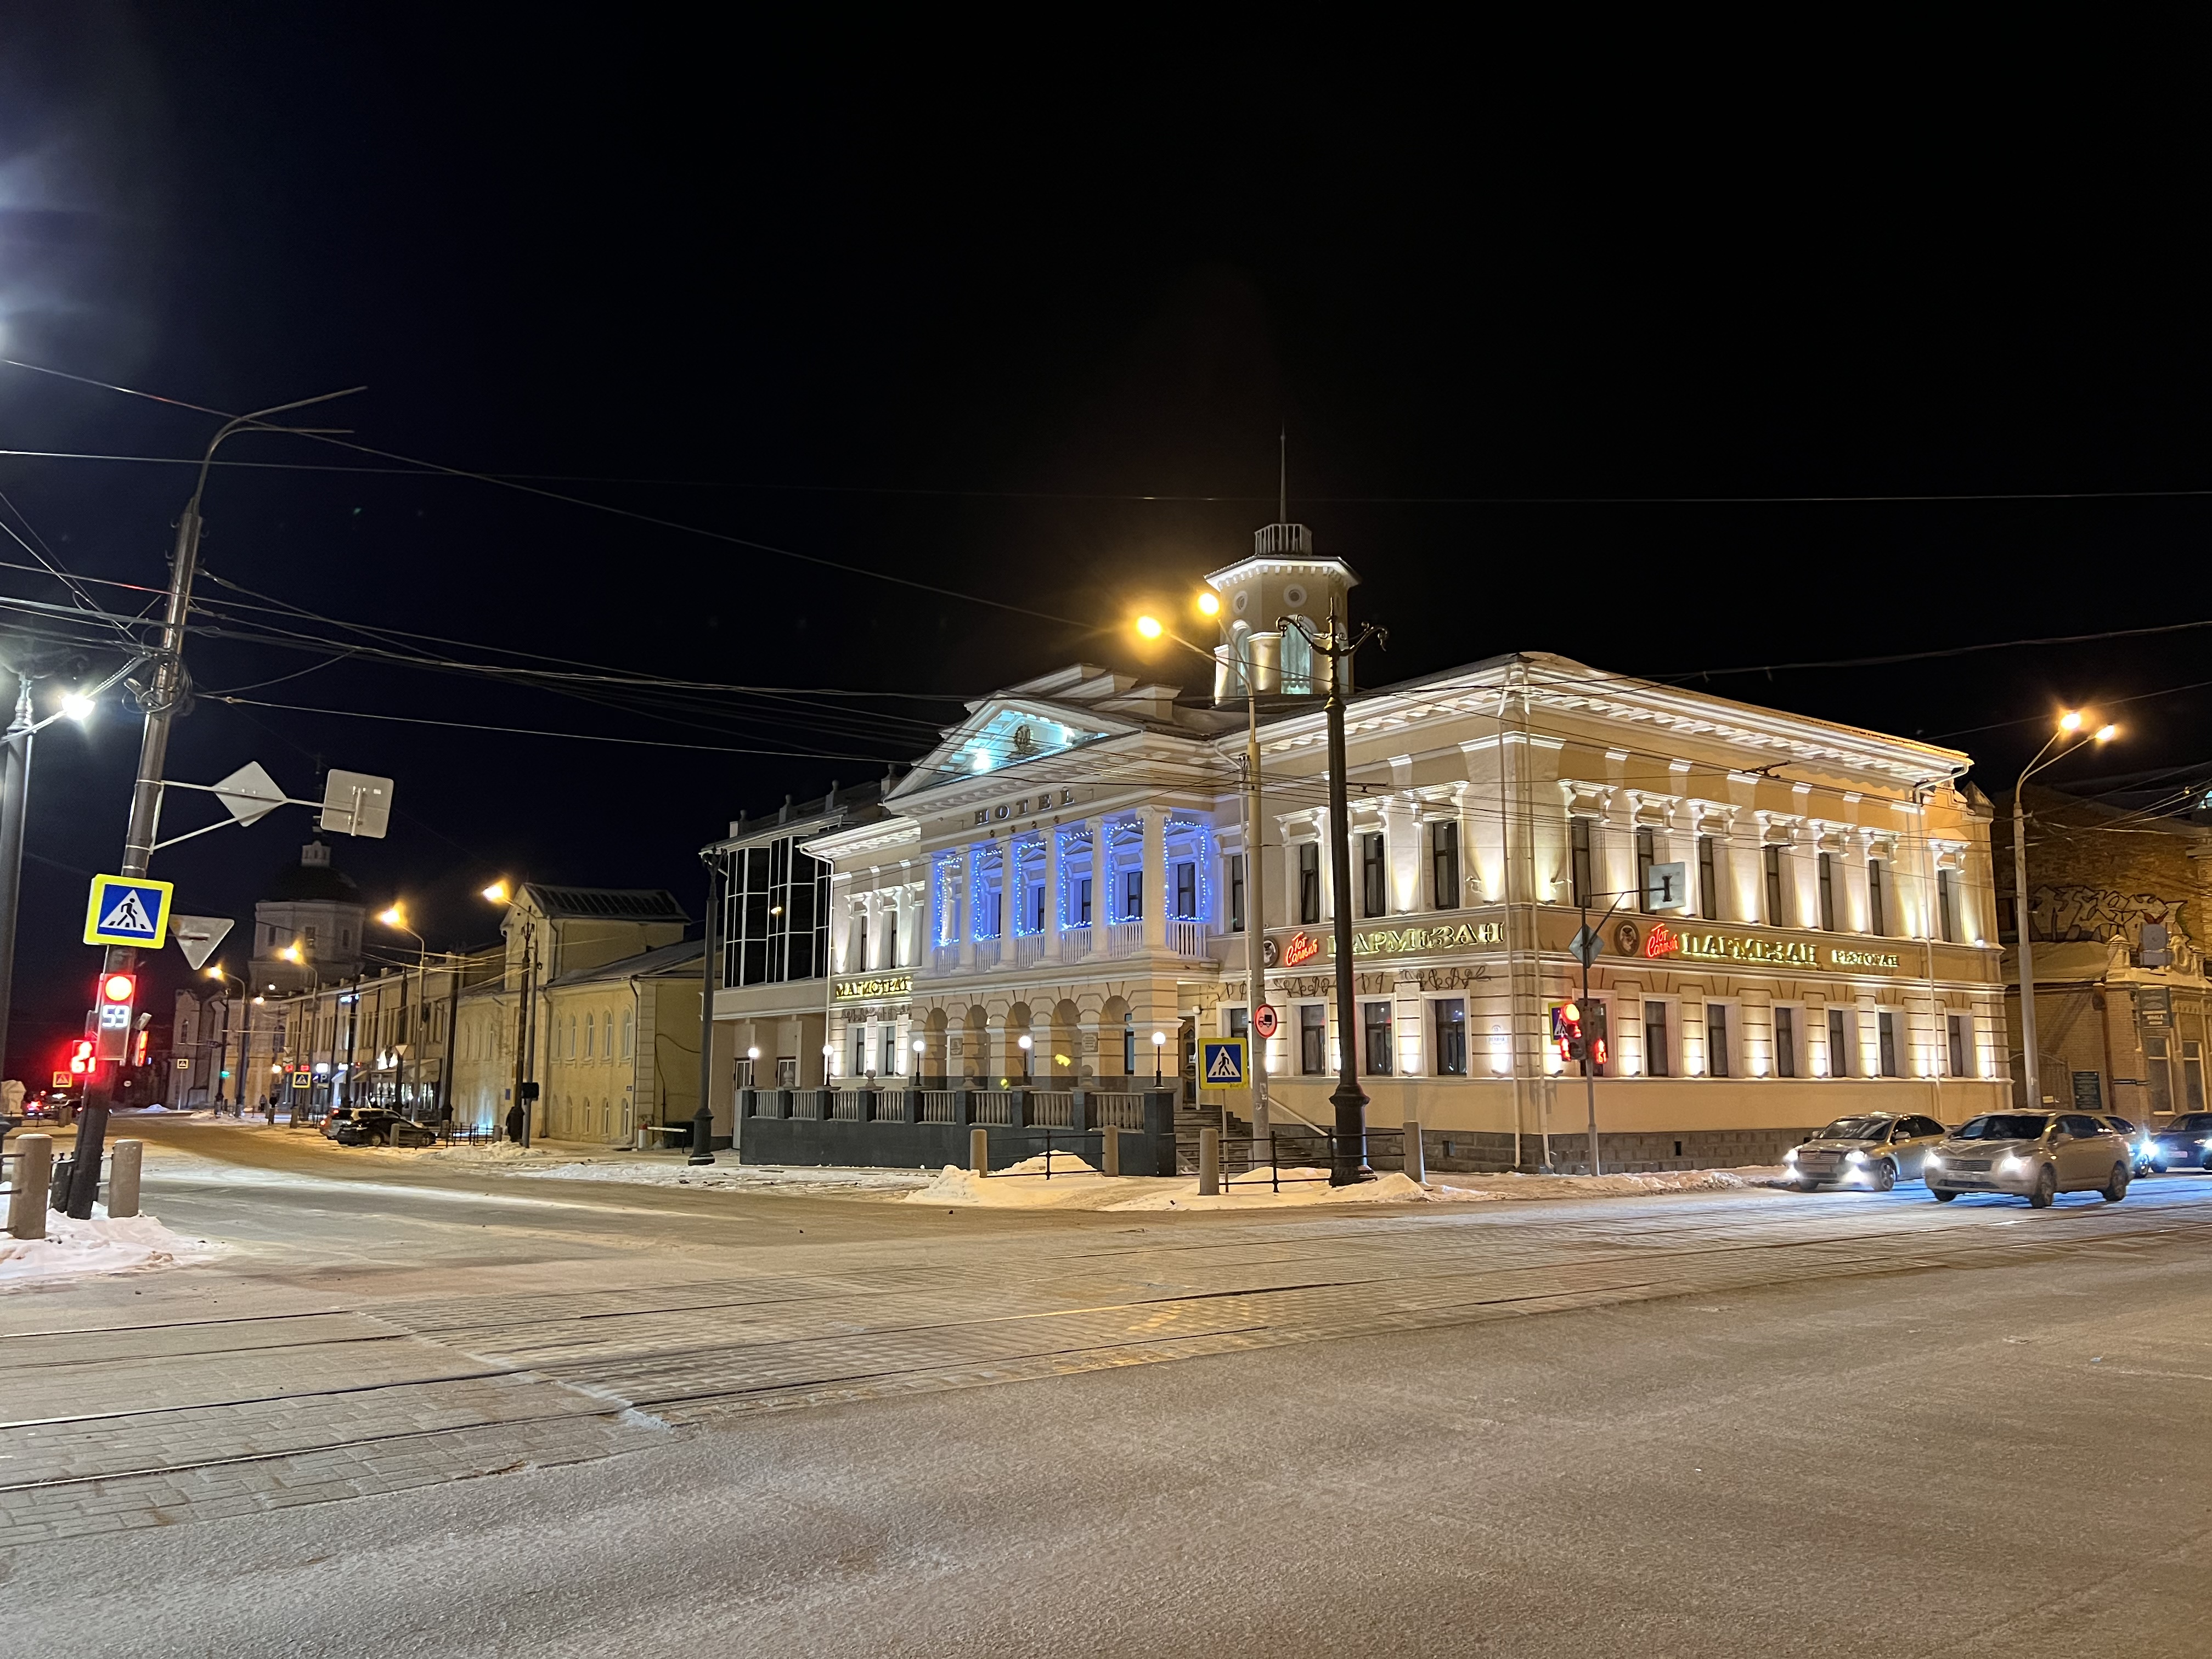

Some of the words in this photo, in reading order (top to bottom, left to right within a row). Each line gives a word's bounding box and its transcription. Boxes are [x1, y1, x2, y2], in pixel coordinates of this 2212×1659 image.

[974, 787, 1075, 825] HOTEL
[1291, 930, 1308, 952] Тот
[102, 1005, 130, 1028] 59
[71, 1056, 96, 1073] 61
